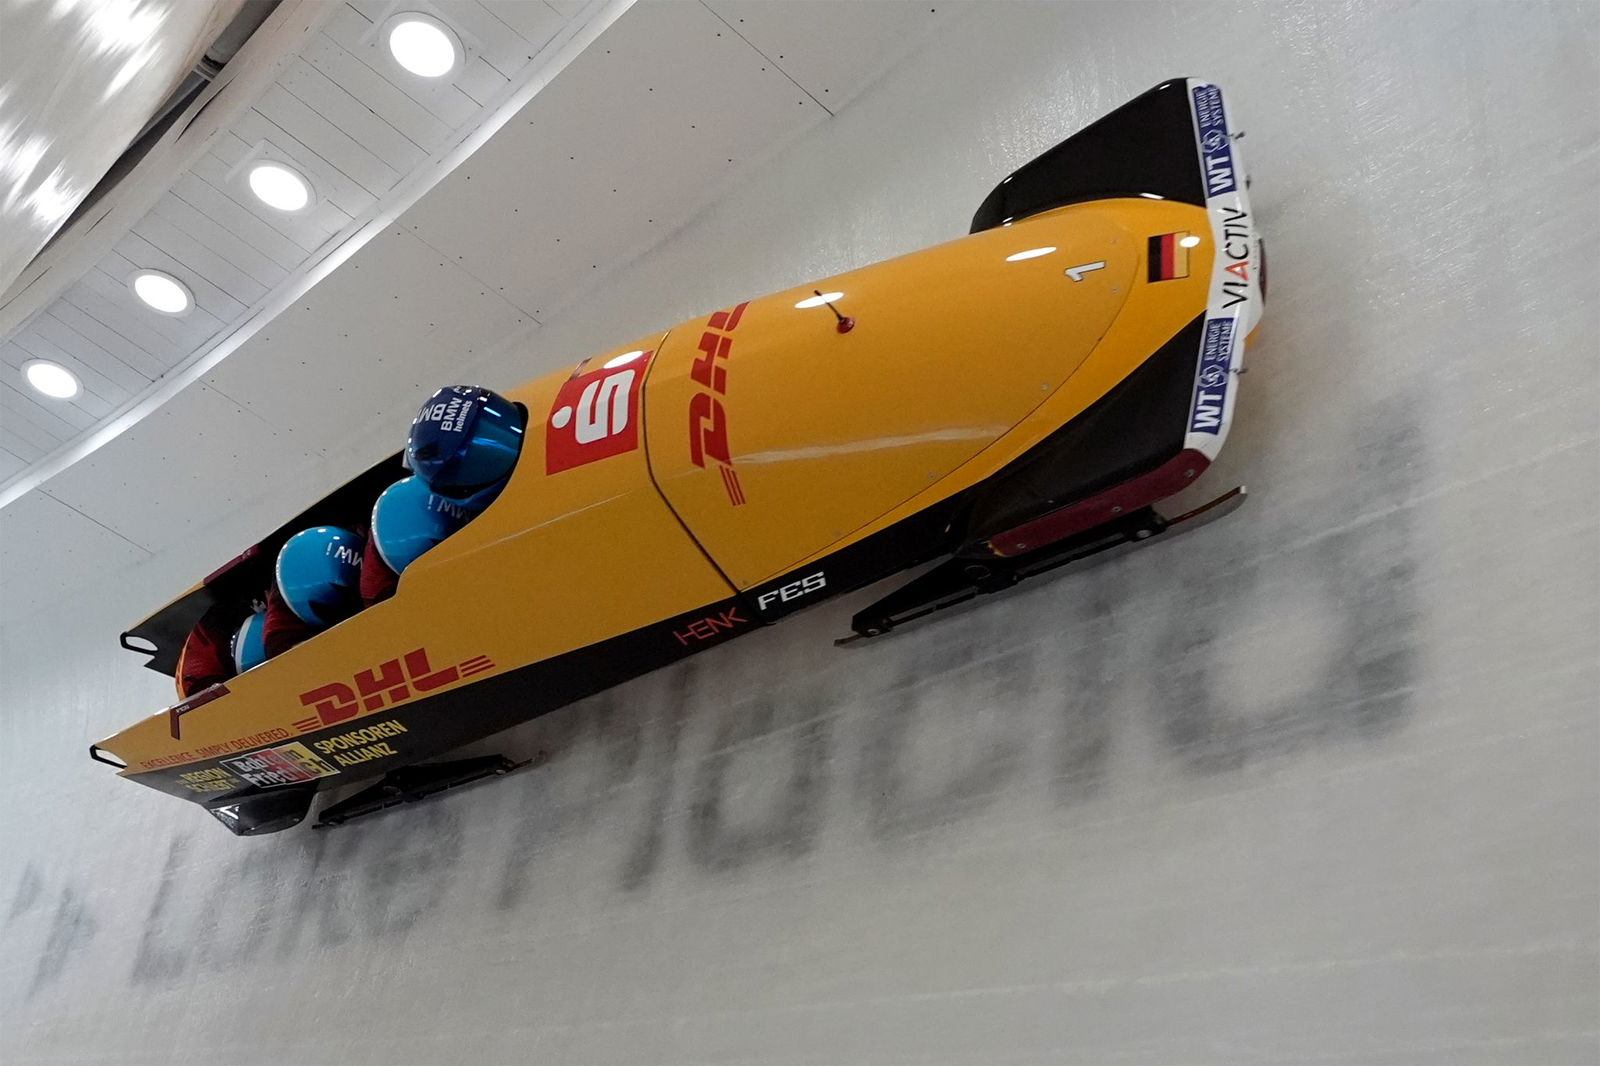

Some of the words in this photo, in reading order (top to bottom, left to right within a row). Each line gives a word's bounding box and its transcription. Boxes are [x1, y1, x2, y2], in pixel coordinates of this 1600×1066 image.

[1206, 155, 1234, 194] WT
[1064, 260, 1106, 282] 1
[1222, 207, 1250, 309] VIACTIV
[1204, 321, 1222, 361] ENERGIE
[1217, 319, 1233, 362] SYSTEME
[689, 301, 750, 470] DHL
[441, 397, 463, 432] BMW
[453, 400, 473, 433] helmets
[1193, 391, 1223, 429] WT
[757, 571, 827, 611] FES
[673, 607, 749, 647] HENK
[300, 648, 460, 727] DHL
[312, 719, 408, 755] SPONSOREN
[332, 742, 398, 767] ALLIANZ
